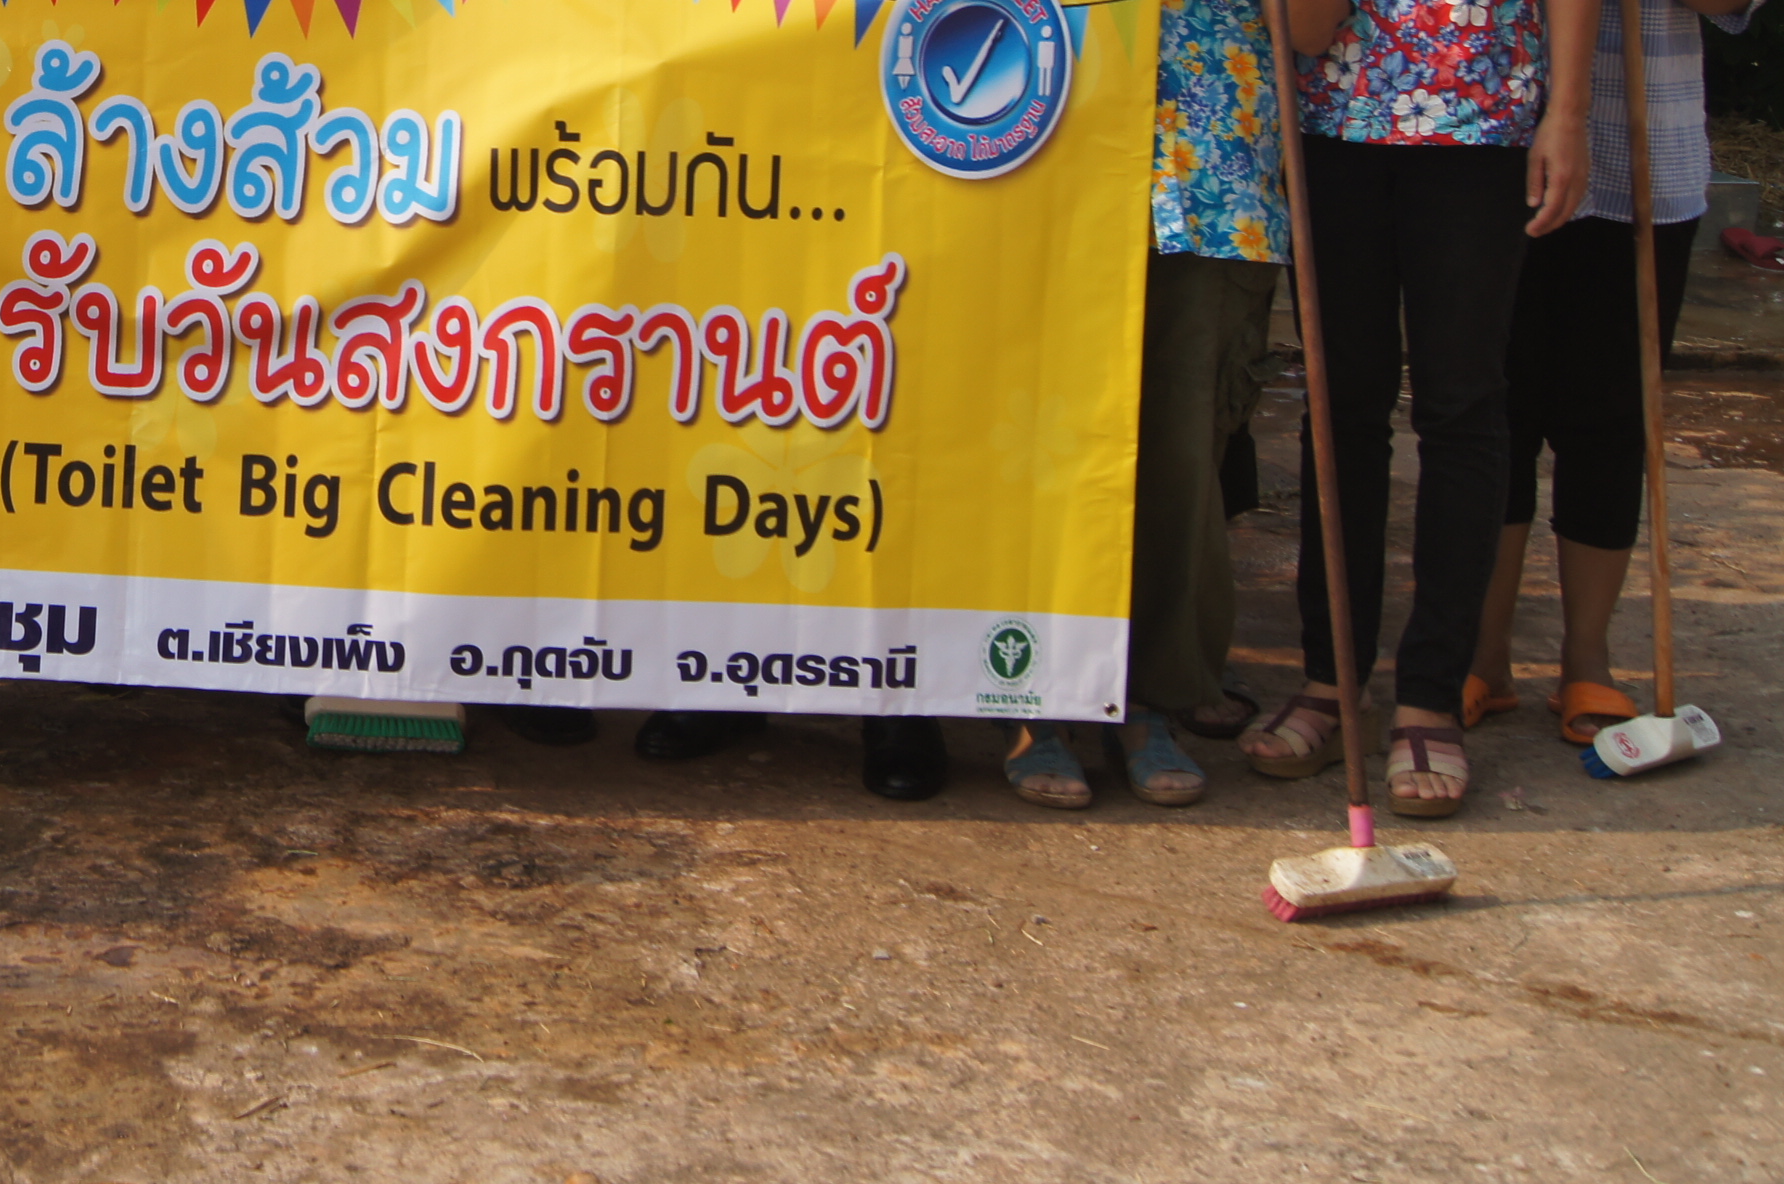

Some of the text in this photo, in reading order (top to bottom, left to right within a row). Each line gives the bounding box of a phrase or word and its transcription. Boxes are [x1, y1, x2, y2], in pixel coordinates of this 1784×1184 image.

[7, 43, 847, 222] ล้างส้วม พร้อมกัน...
[0, 439, 885, 558] (Toilet Big Cleaning Days)
[157, 620, 406, 673] ต.เชียงเพ็ง
[450, 636, 633, 690] อ.กุดจับ
[676, 645, 917, 697] จ.อุดรธานี
